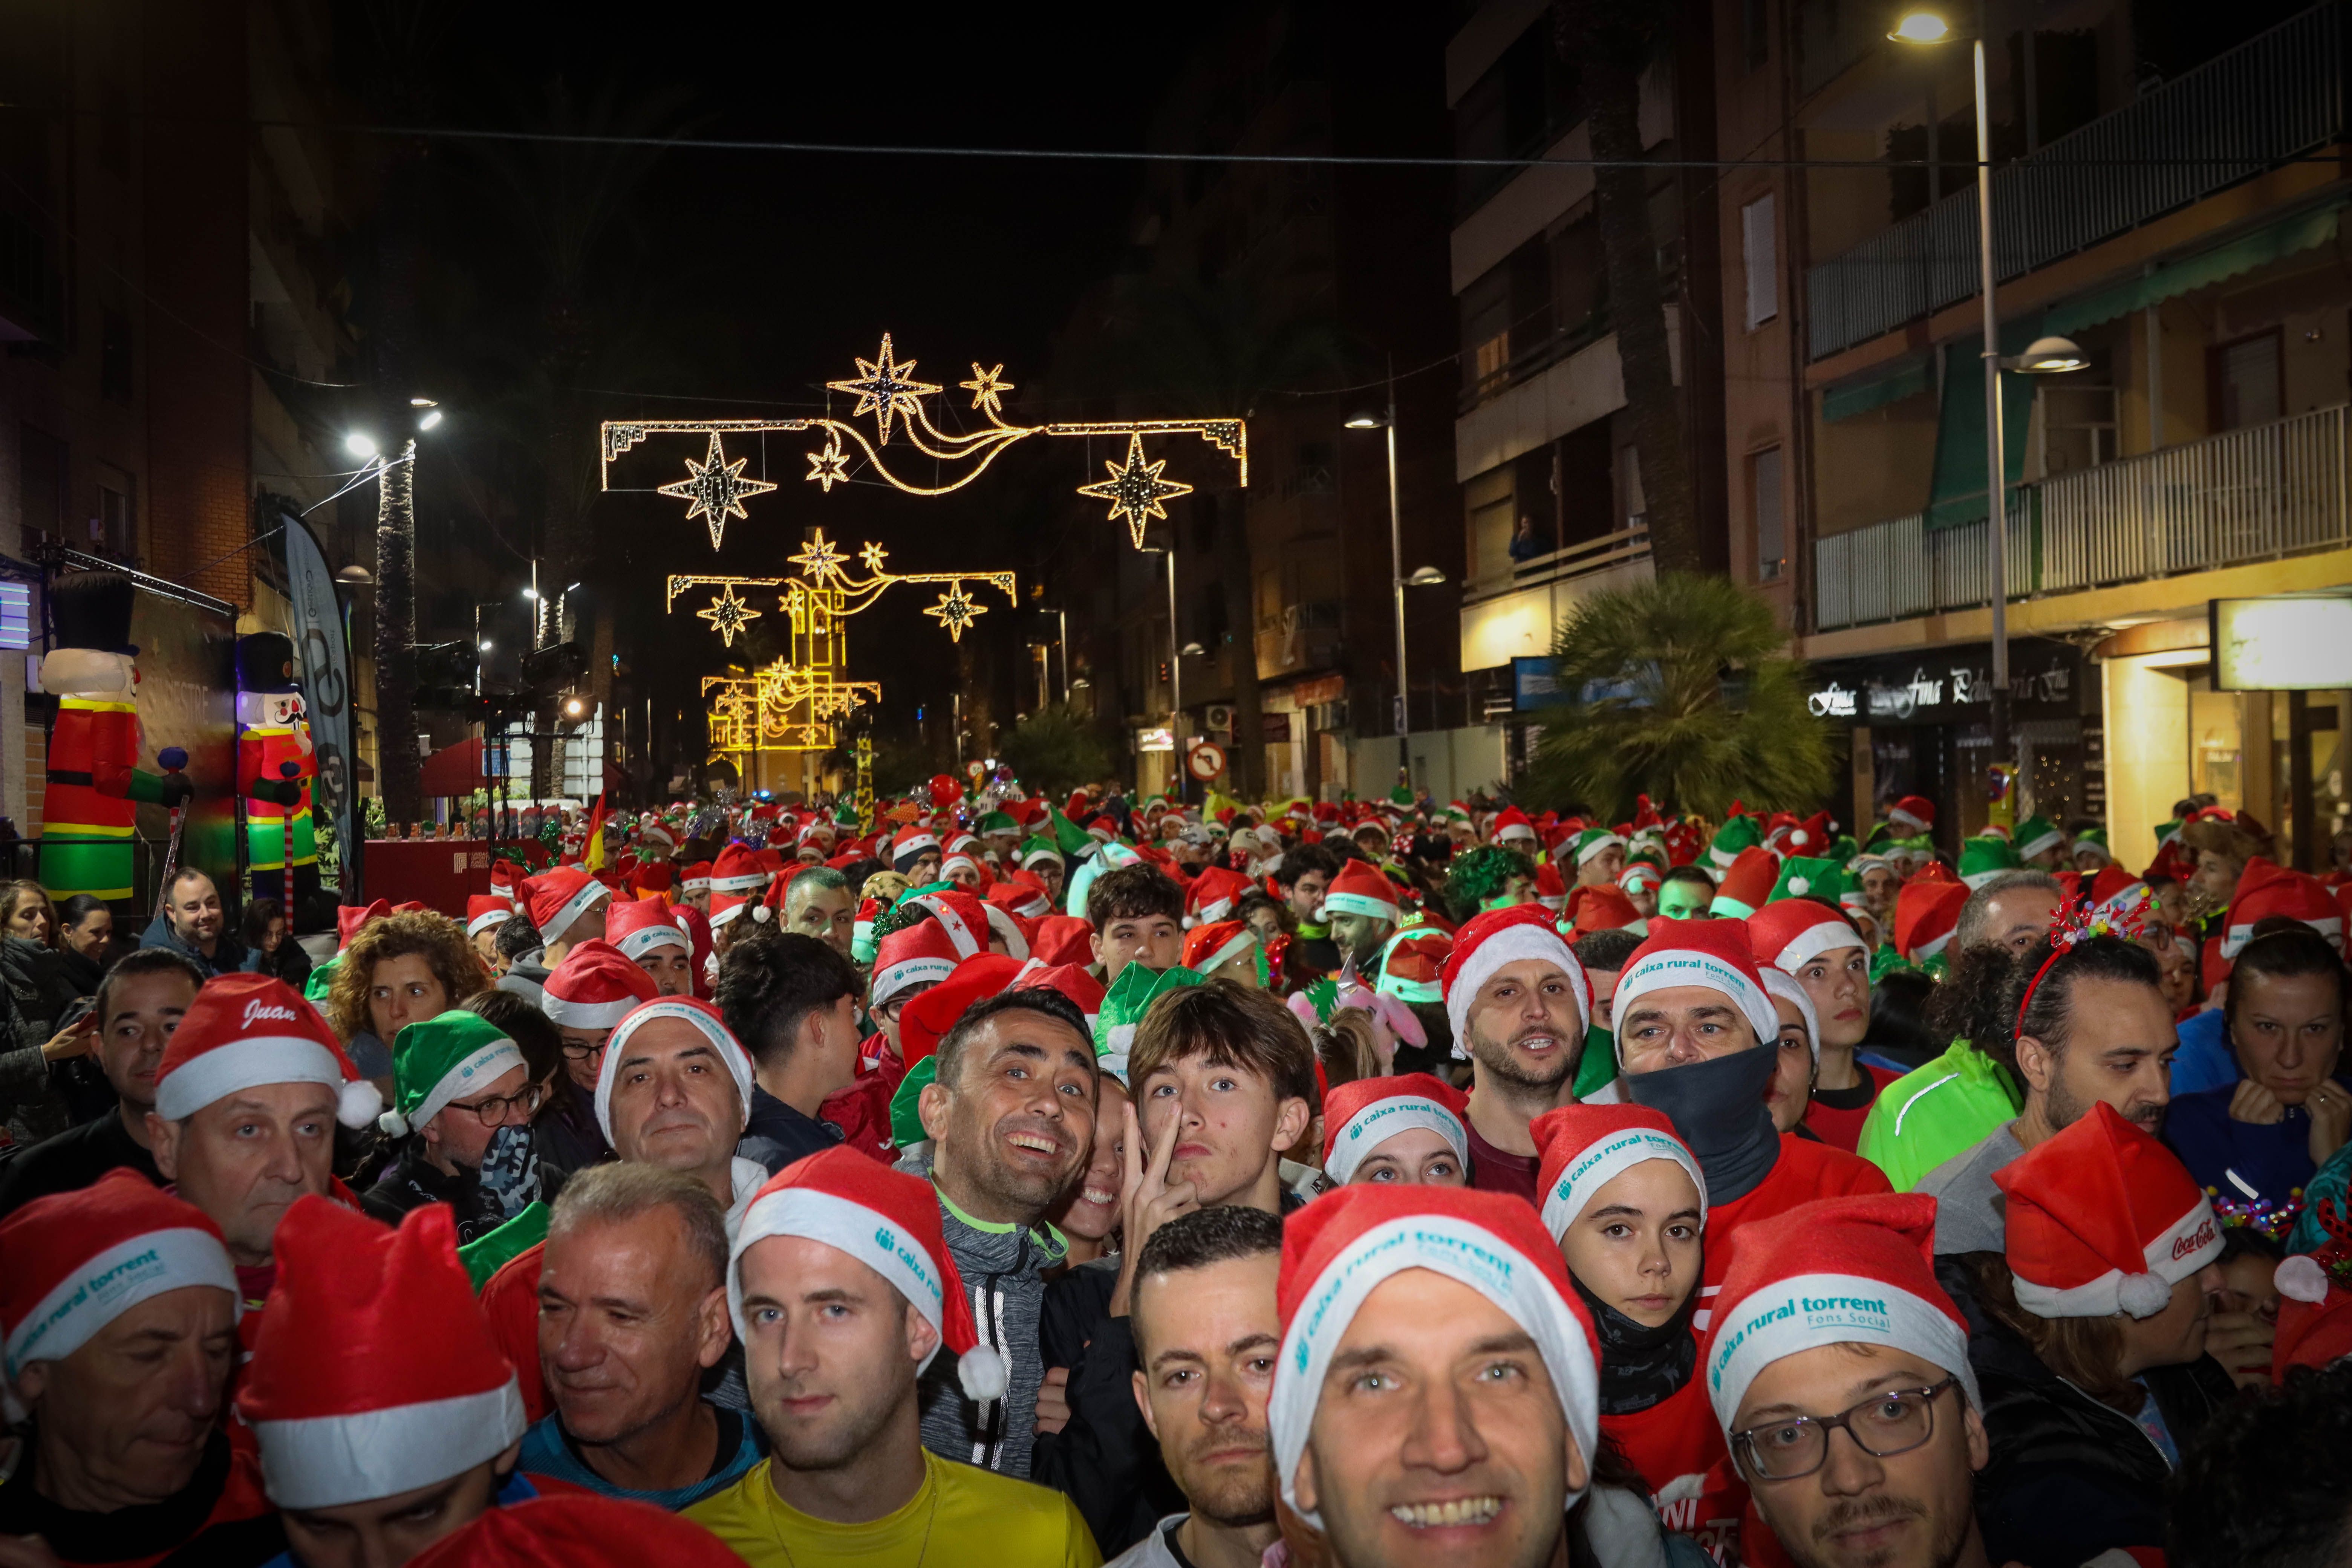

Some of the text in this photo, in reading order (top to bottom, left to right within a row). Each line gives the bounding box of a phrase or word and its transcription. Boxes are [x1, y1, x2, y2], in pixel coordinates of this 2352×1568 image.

[906, 965, 928, 973] caixa
[1635, 959, 1745, 989] caixa rural torrent
[241, 998, 297, 1030] Juan
[474, 1053, 495, 1068] caixa
[1364, 1106, 1396, 1125] caixa
[1572, 1153, 1602, 1182] caixa
[1604, 1135, 1642, 1155] rural
[2172, 1218, 2216, 1261] Coca-Cola
[898, 1247, 925, 1281] caixa
[49, 1286, 87, 1324] rural
[89, 1249, 159, 1292] torrent
[1308, 1230, 1513, 1337] caixa rural torrent
[1719, 1297, 1888, 1370] caixa rural torrent
[1808, 1312, 1890, 1328] Fons Social
